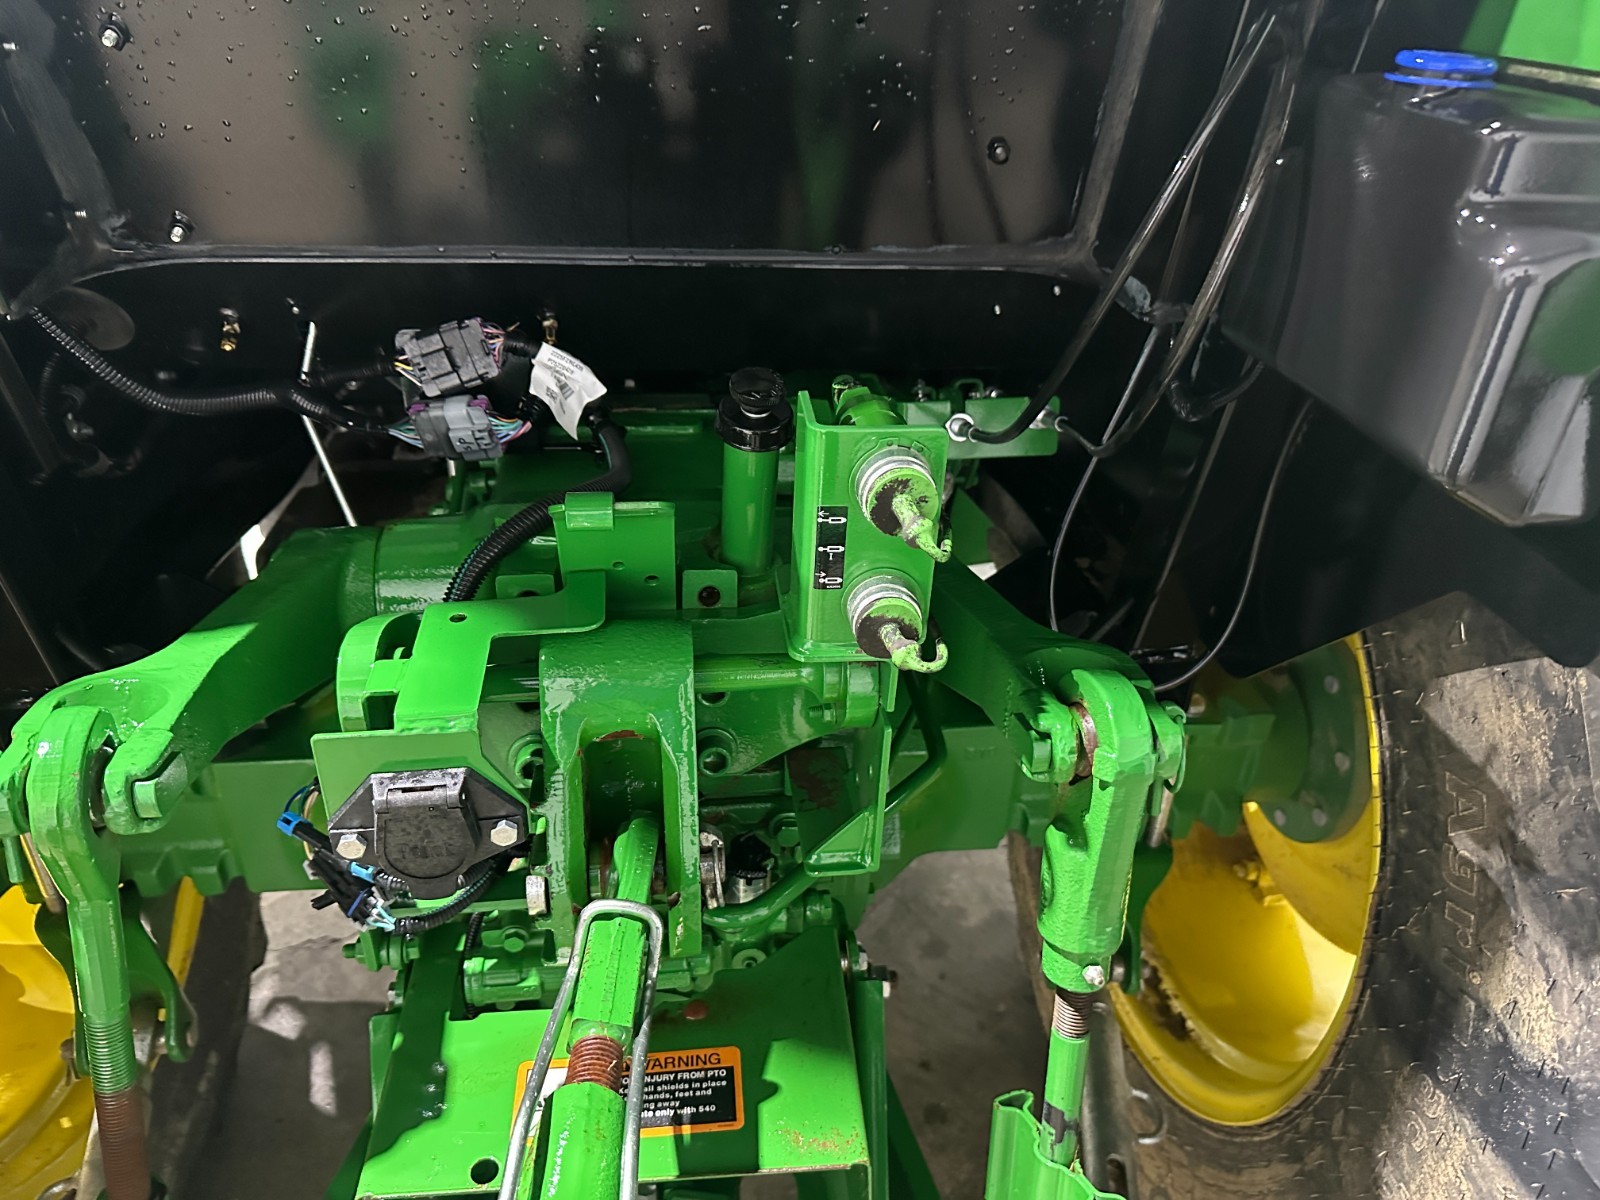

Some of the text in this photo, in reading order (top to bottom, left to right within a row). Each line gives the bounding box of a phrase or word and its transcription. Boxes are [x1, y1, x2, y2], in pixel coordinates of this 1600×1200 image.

[645, 1053, 721, 1070] ARNING
[644, 1069, 727, 1083] NJURY FROM PTO
[657, 1082, 689, 1091] shields
[702, 1080, 727, 1089] place
[643, 1088, 712, 1100] hands, feet and
[657, 1100, 680, 1108] away
[655, 1108, 675, 1117] only
[677, 1106, 696, 1115] with
[699, 1105, 716, 1113] 540
